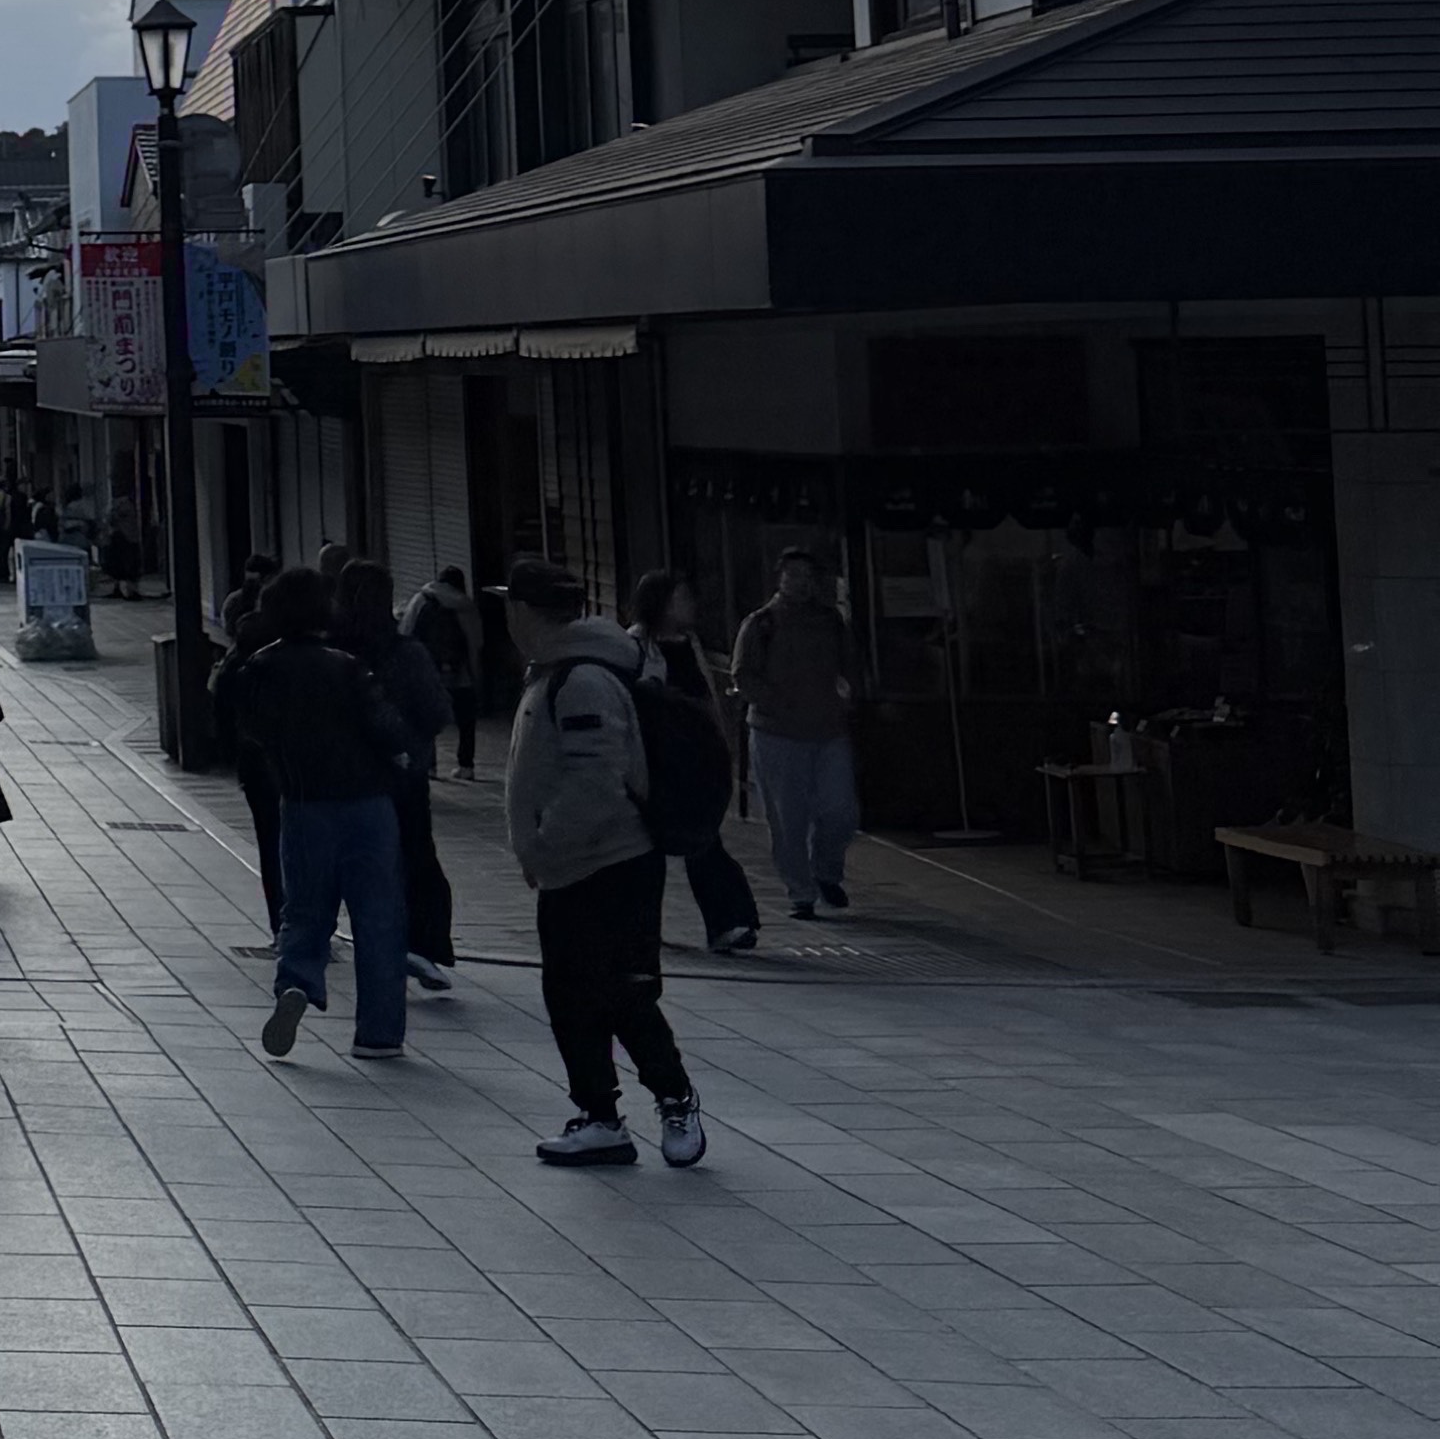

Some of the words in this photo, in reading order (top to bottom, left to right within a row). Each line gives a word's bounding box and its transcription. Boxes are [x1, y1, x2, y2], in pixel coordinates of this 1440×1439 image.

[112, 289, 137, 396] 門前まつり
